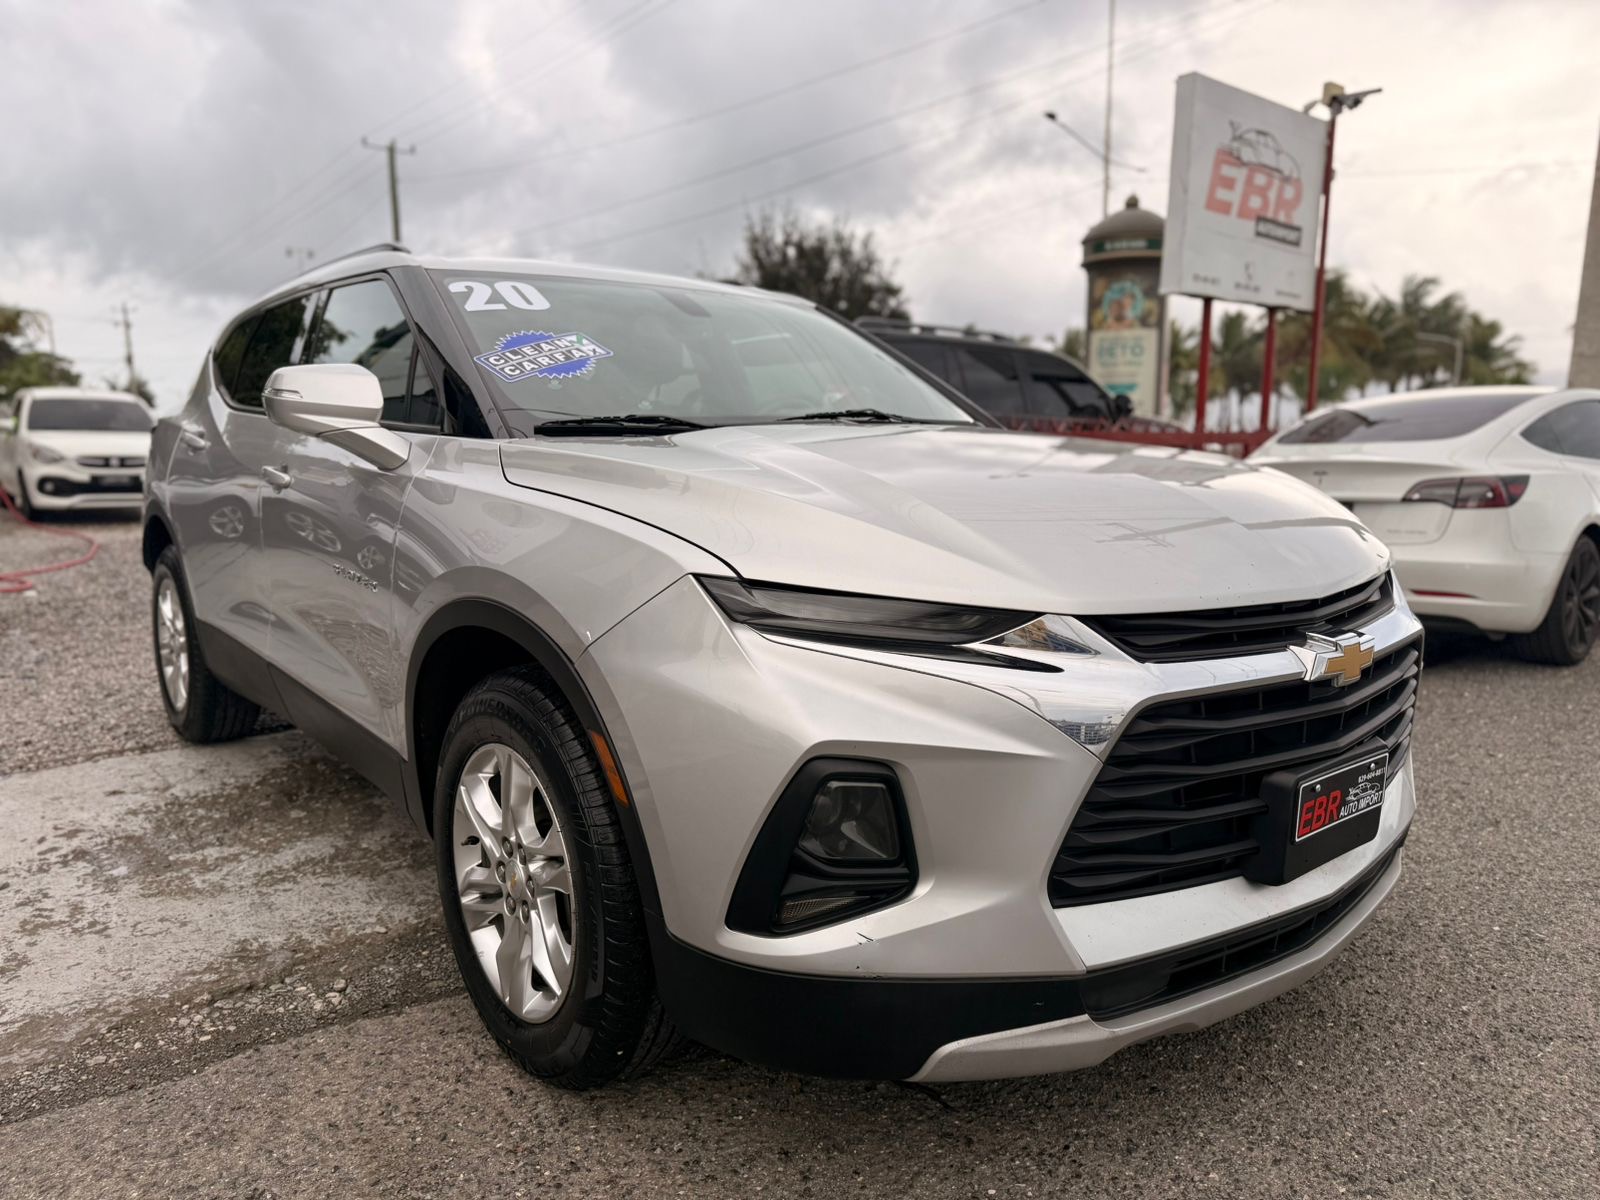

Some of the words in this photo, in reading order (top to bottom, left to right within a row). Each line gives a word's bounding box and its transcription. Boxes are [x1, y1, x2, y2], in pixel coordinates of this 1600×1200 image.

[1205, 147, 1304, 225] EBR
[447, 280, 551, 312] 20
[488, 337, 572, 366] CLEAN
[503, 345, 605, 376] CARFAX
[1299, 790, 1341, 836] EBR
[1339, 804, 1358, 819] AUTO
[1358, 792, 1382, 809] IMPORT
